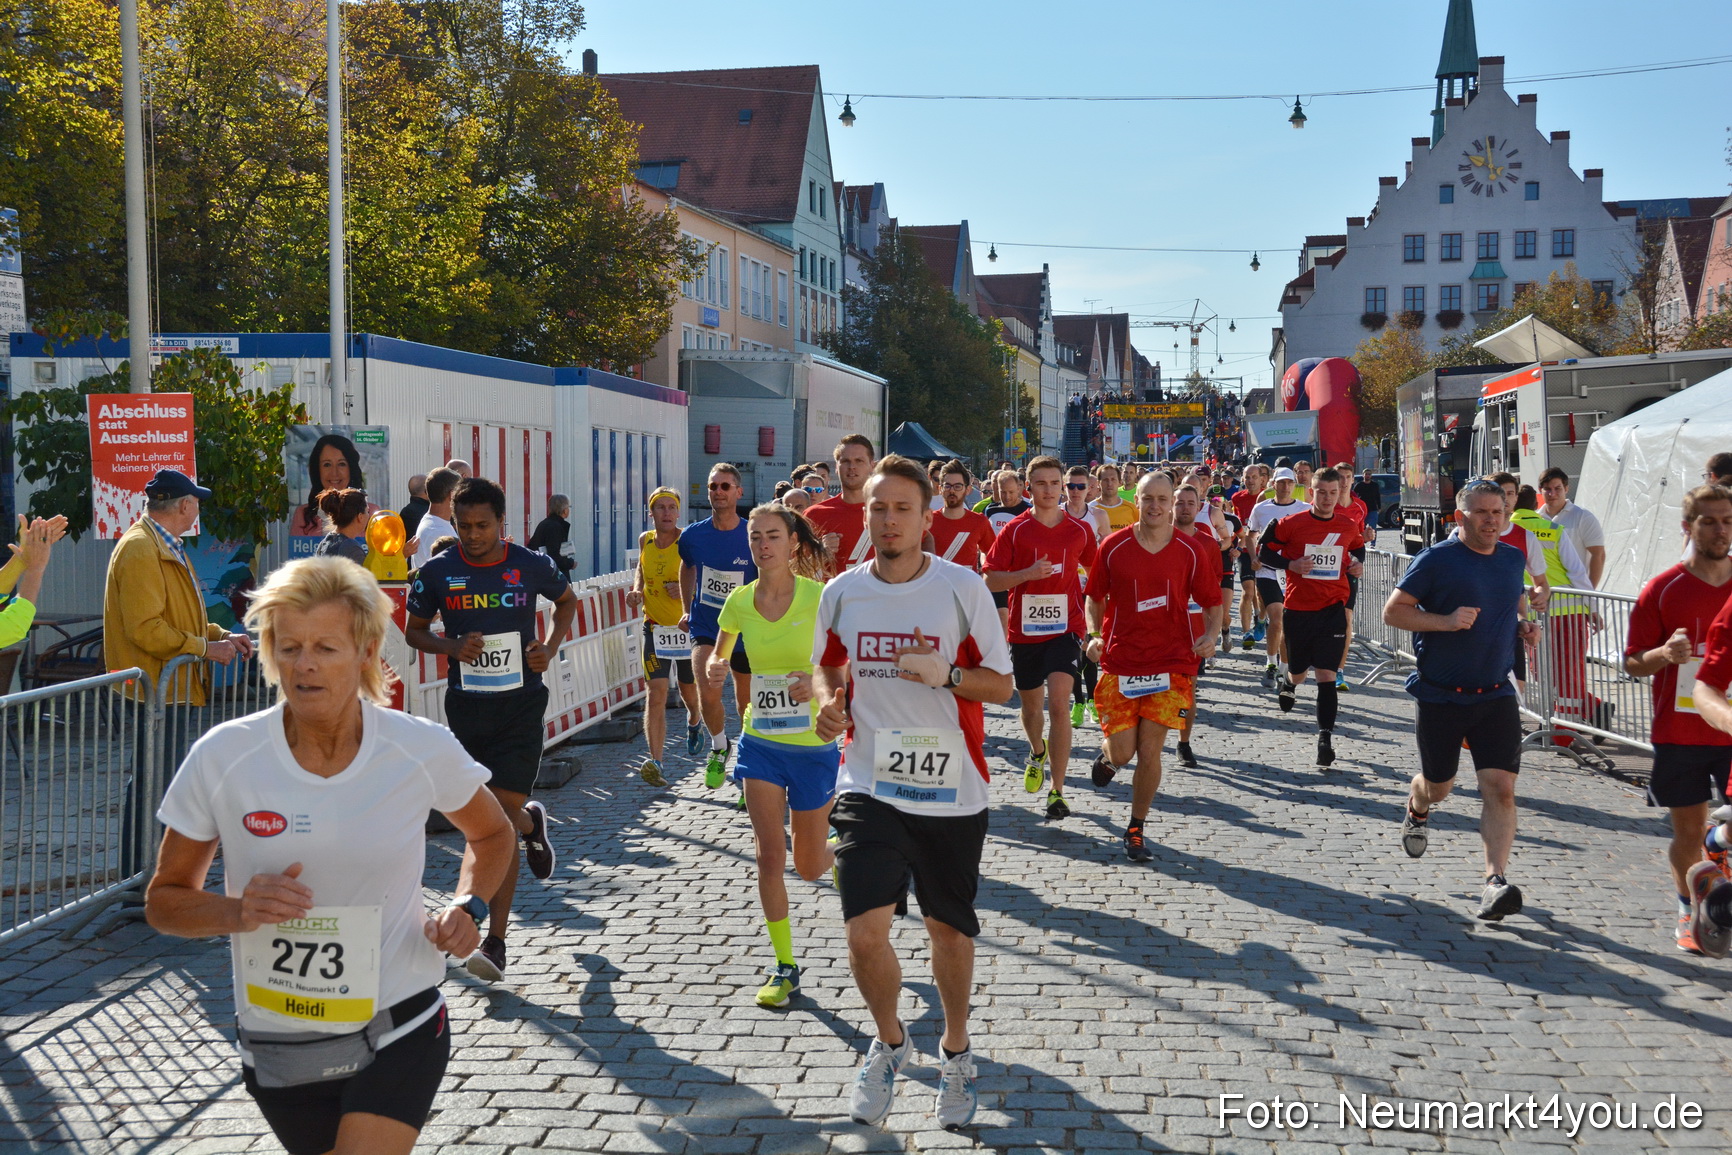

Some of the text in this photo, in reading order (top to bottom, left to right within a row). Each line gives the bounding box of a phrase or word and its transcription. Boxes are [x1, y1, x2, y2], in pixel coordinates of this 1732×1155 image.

[0, 290, 22, 299] rkschein
[98, 404, 187, 418] Abschluss
[1136, 406, 1171, 416] START
[98, 420, 128, 430] statt
[100, 431, 188, 444] Ausschluss!
[116, 452, 185, 462] Mehr Lehrer für
[112, 463, 186, 473] kleinere Klassen.
[1311, 554, 1337, 565] 2619
[707, 578, 736, 594] 2635
[445, 592, 527, 610] MENSCH
[1029, 606, 1061, 619] 2455
[659, 633, 687, 645] 3119
[902, 735, 939, 745] BOCK
[888, 751, 950, 776] 2147
[895, 785, 937, 800] Andreas
[246, 815, 284, 832] Hervis
[272, 938, 345, 980] 273
[268, 977, 336, 994] PARTL Neumarkt
[286, 998, 325, 1017] Heidi
